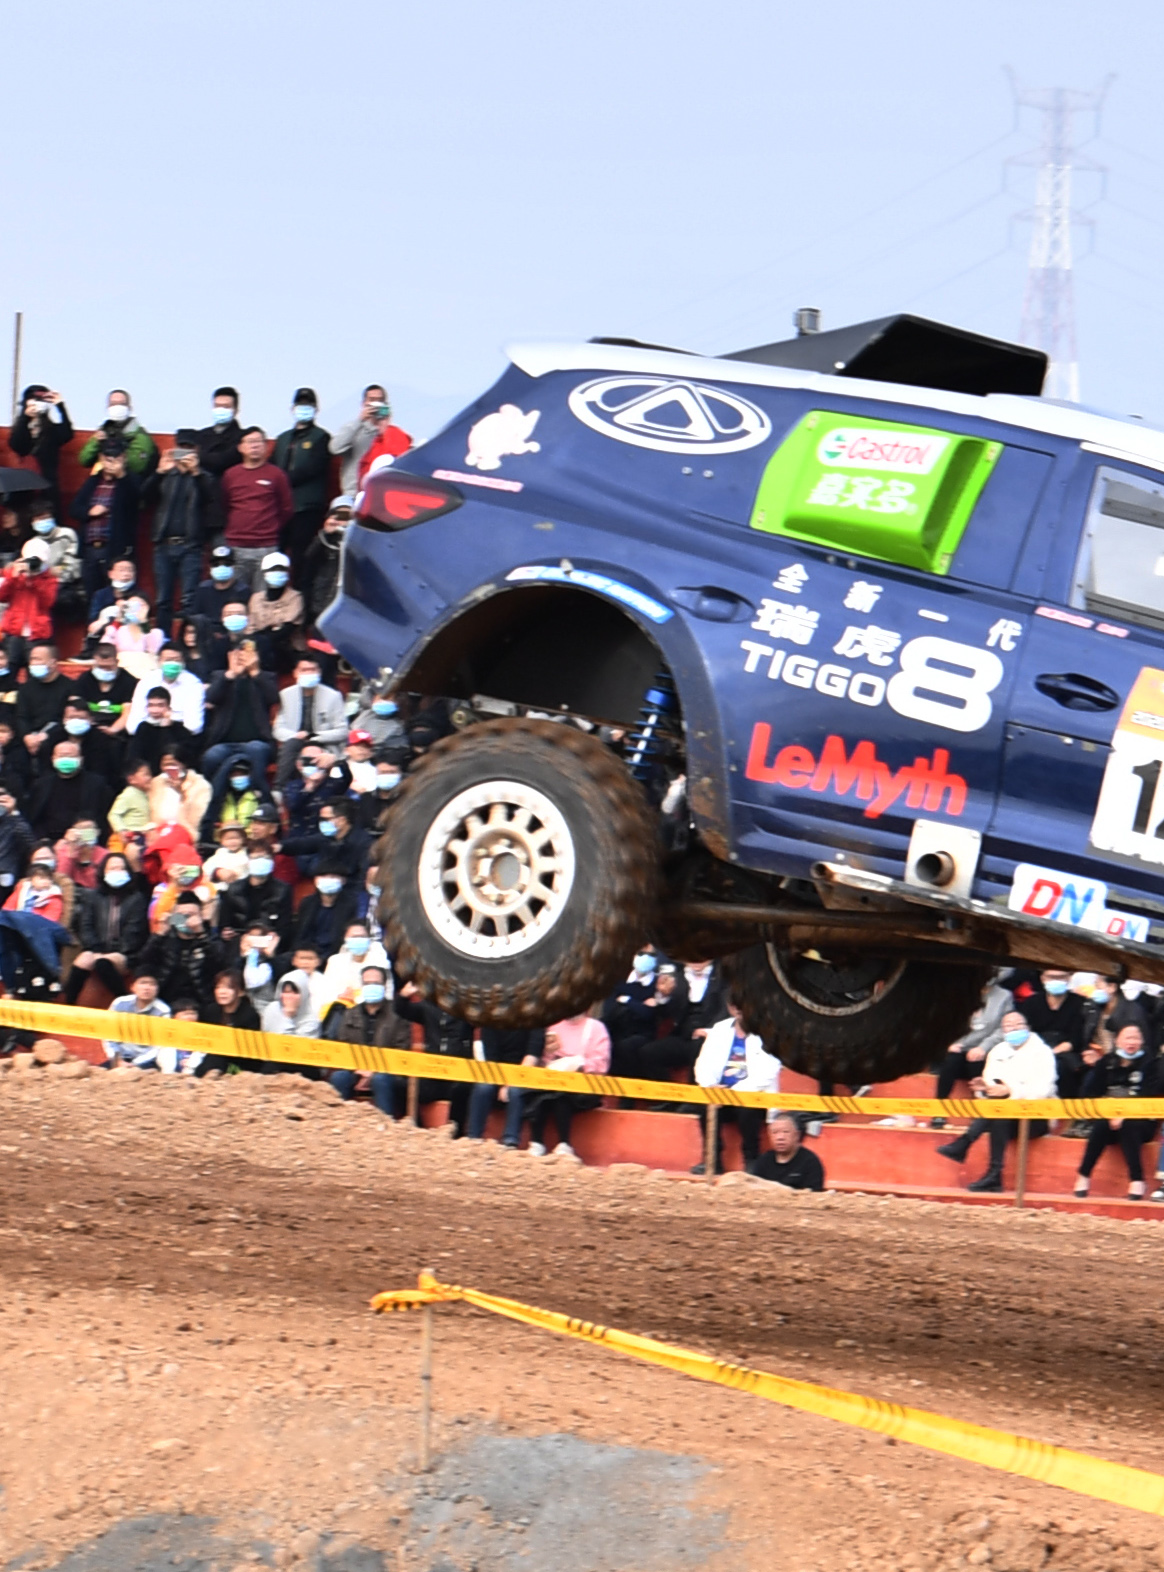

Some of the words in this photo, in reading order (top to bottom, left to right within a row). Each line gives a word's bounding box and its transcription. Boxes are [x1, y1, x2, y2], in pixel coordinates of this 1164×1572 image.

[848, 436, 932, 465] Castrol
[751, 598, 902, 667] 瑞虎
[772, 563, 1022, 652] 全新一代
[740, 640, 887, 707] TIGGO
[887, 636, 1004, 732] 8
[745, 722, 967, 819] LeMyth
[1021, 877, 1096, 926] DN
